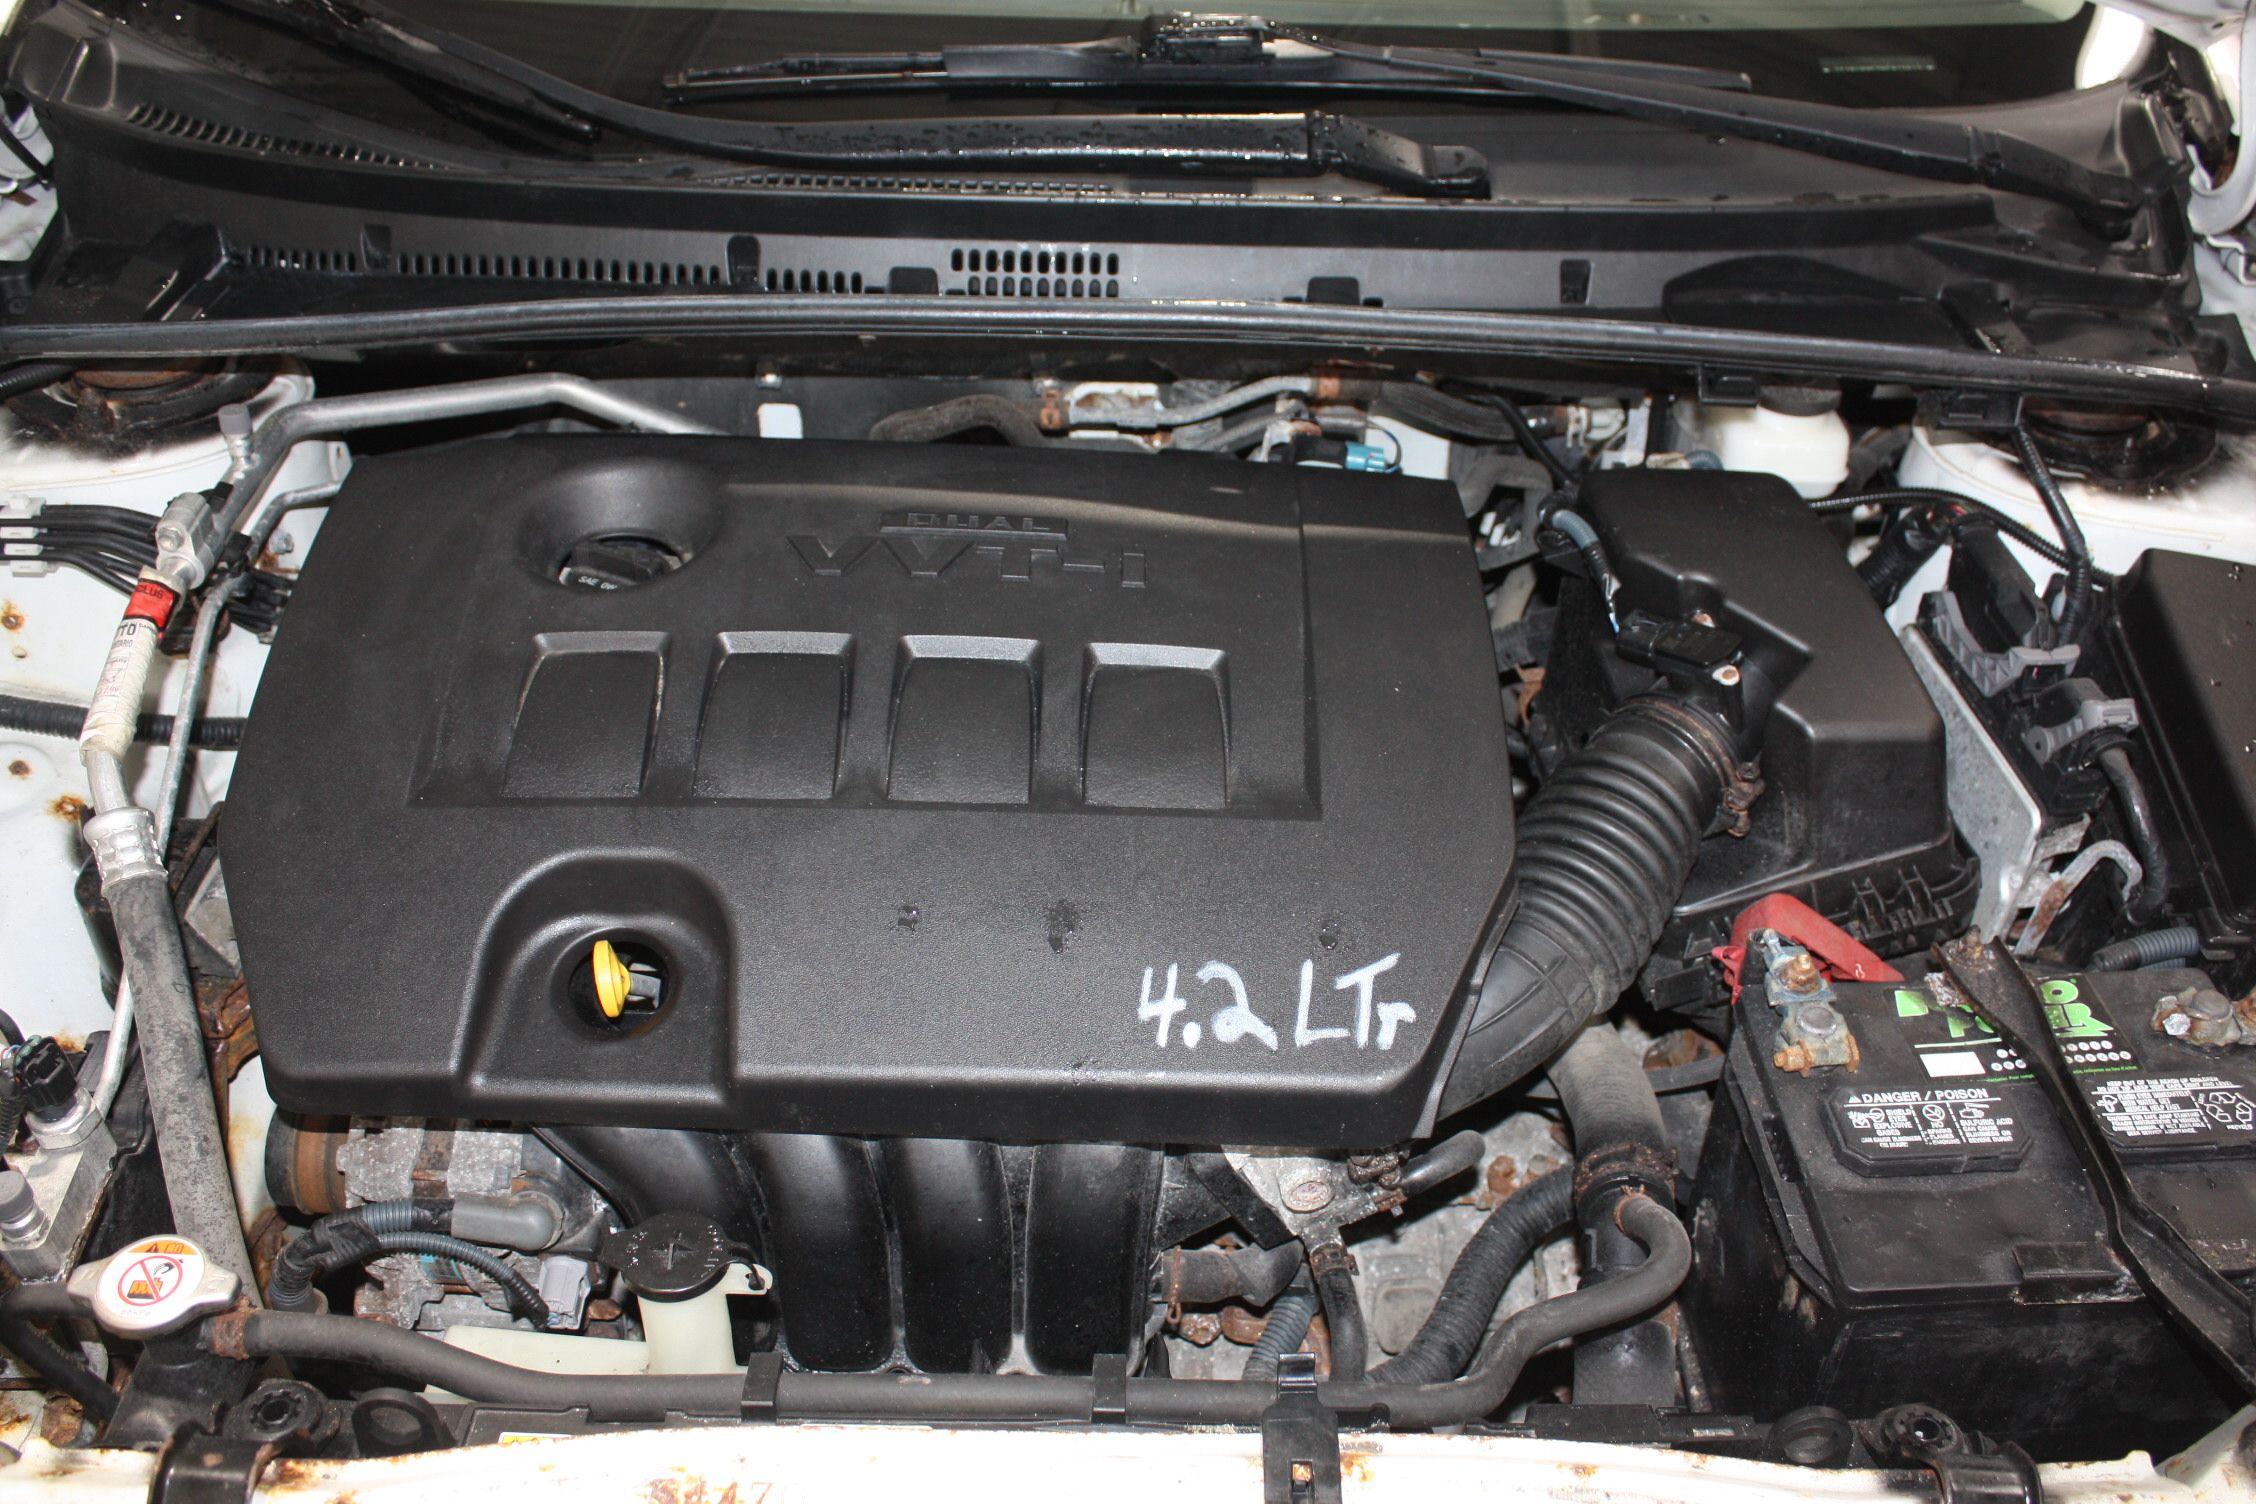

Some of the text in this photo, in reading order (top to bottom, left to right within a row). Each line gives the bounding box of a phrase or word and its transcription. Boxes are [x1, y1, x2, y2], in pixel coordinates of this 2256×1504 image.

[906, 511, 1050, 533] DUAL
[578, 575, 600, 586] SAE
[1862, 1091, 1922, 1104] DANGER
[1935, 1088, 1989, 1101] POISON
[1959, 1118, 2013, 1127] SULFURIC ACID
